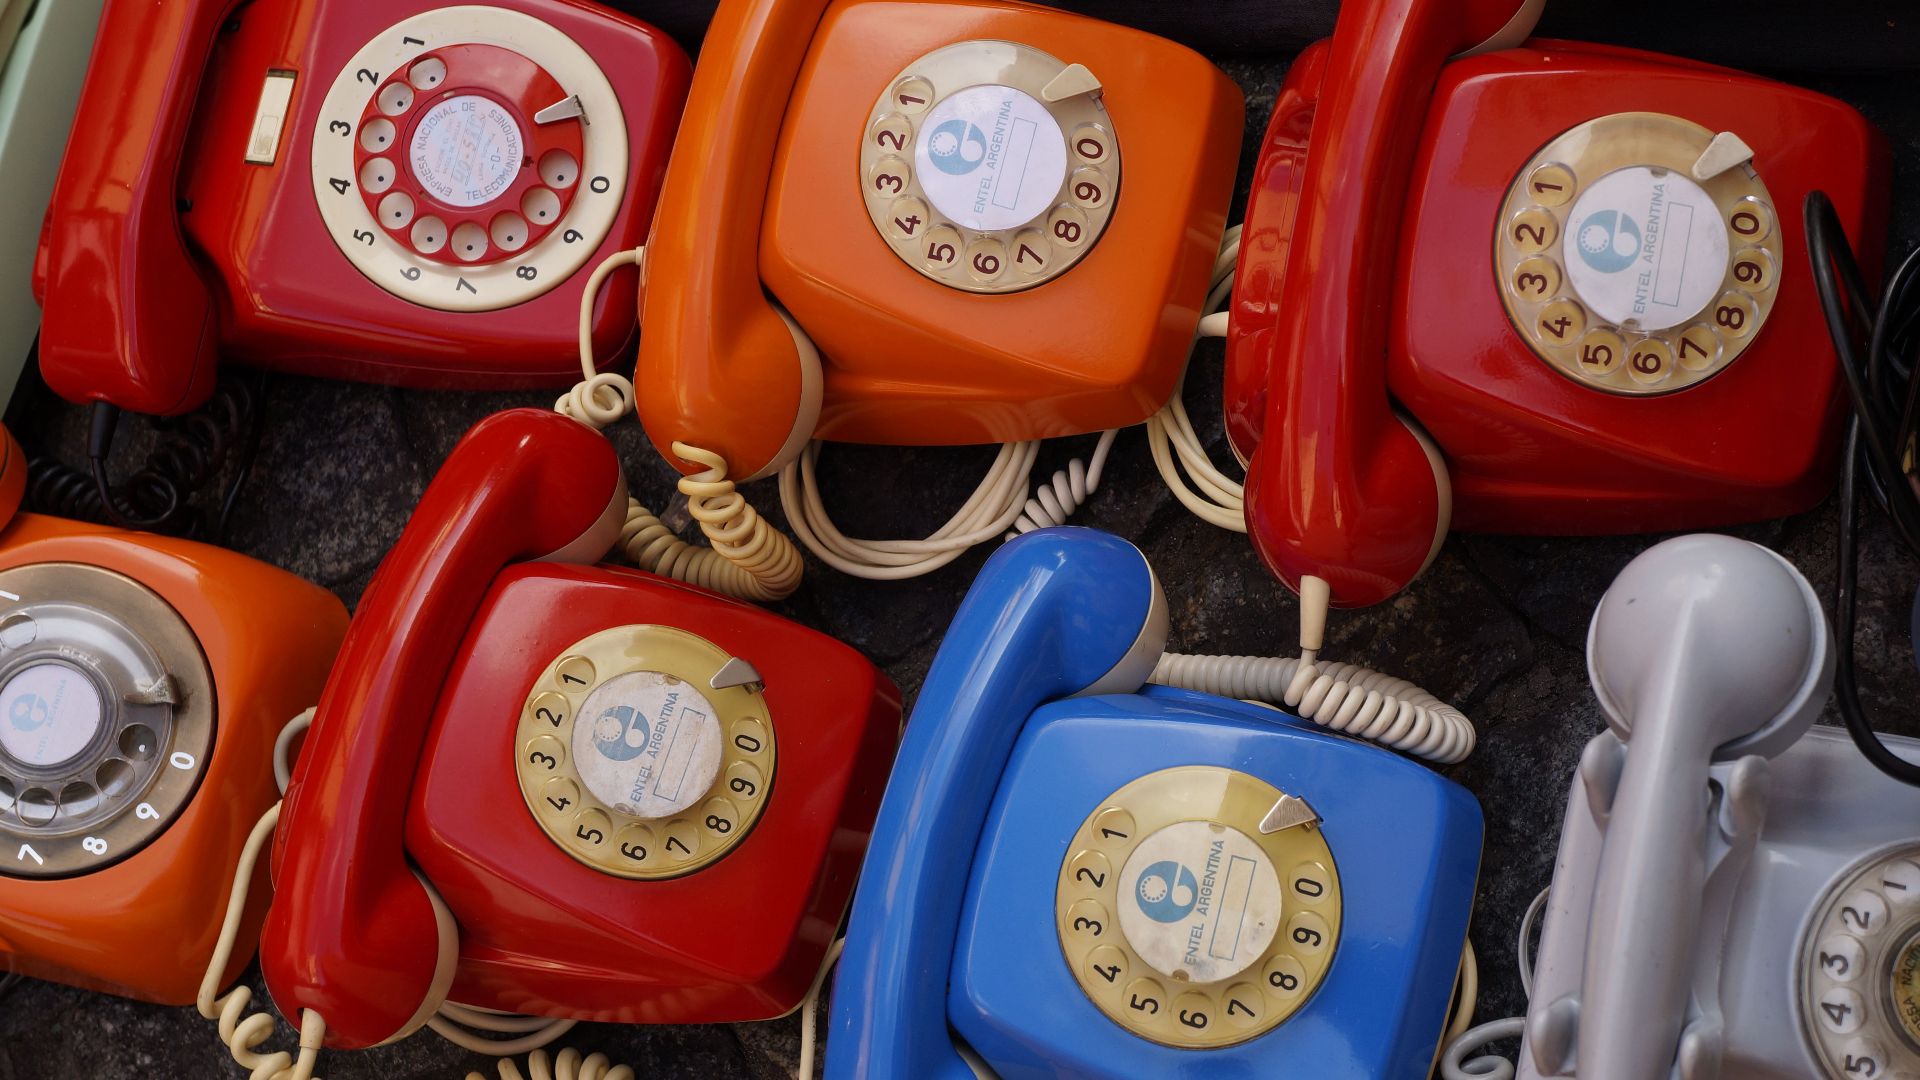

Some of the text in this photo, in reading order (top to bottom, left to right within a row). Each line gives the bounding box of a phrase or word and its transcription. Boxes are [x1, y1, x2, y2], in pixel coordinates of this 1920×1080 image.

[329, 36, 610, 295] 1 2 3 4 5 6 7 8 9 0
[417, 105, 457, 150] NACIONAL
[461, 102, 476, 112] DE
[465, 108, 517, 200] TELECOMUNICACIONES
[973, 100, 1013, 214] ENTEL ARGENTINA
[417, 155, 452, 197] EMPRESA
[875, 94, 1104, 275] 1 2 3 4 5 6 7 8 9 0
[1515, 181, 1763, 375] 1 2 3 4 5 6 7 8 9 0
[1633, 183, 1665, 314] ENTEL ARGENTINA
[18, 751, 195, 865] 7 8 9 0
[530, 673, 761, 861] 1 2 3 4 5 6 7 8 9 0
[630, 692, 679, 803] ENTEL ARGENTINA
[1073, 828, 1323, 1029] 1 2 3 4 5 6 7 8 9 0
[1184, 840, 1224, 966] ENTEL ARGENTINA
[1820, 880, 1907, 1078] 1 2 3 4 5
